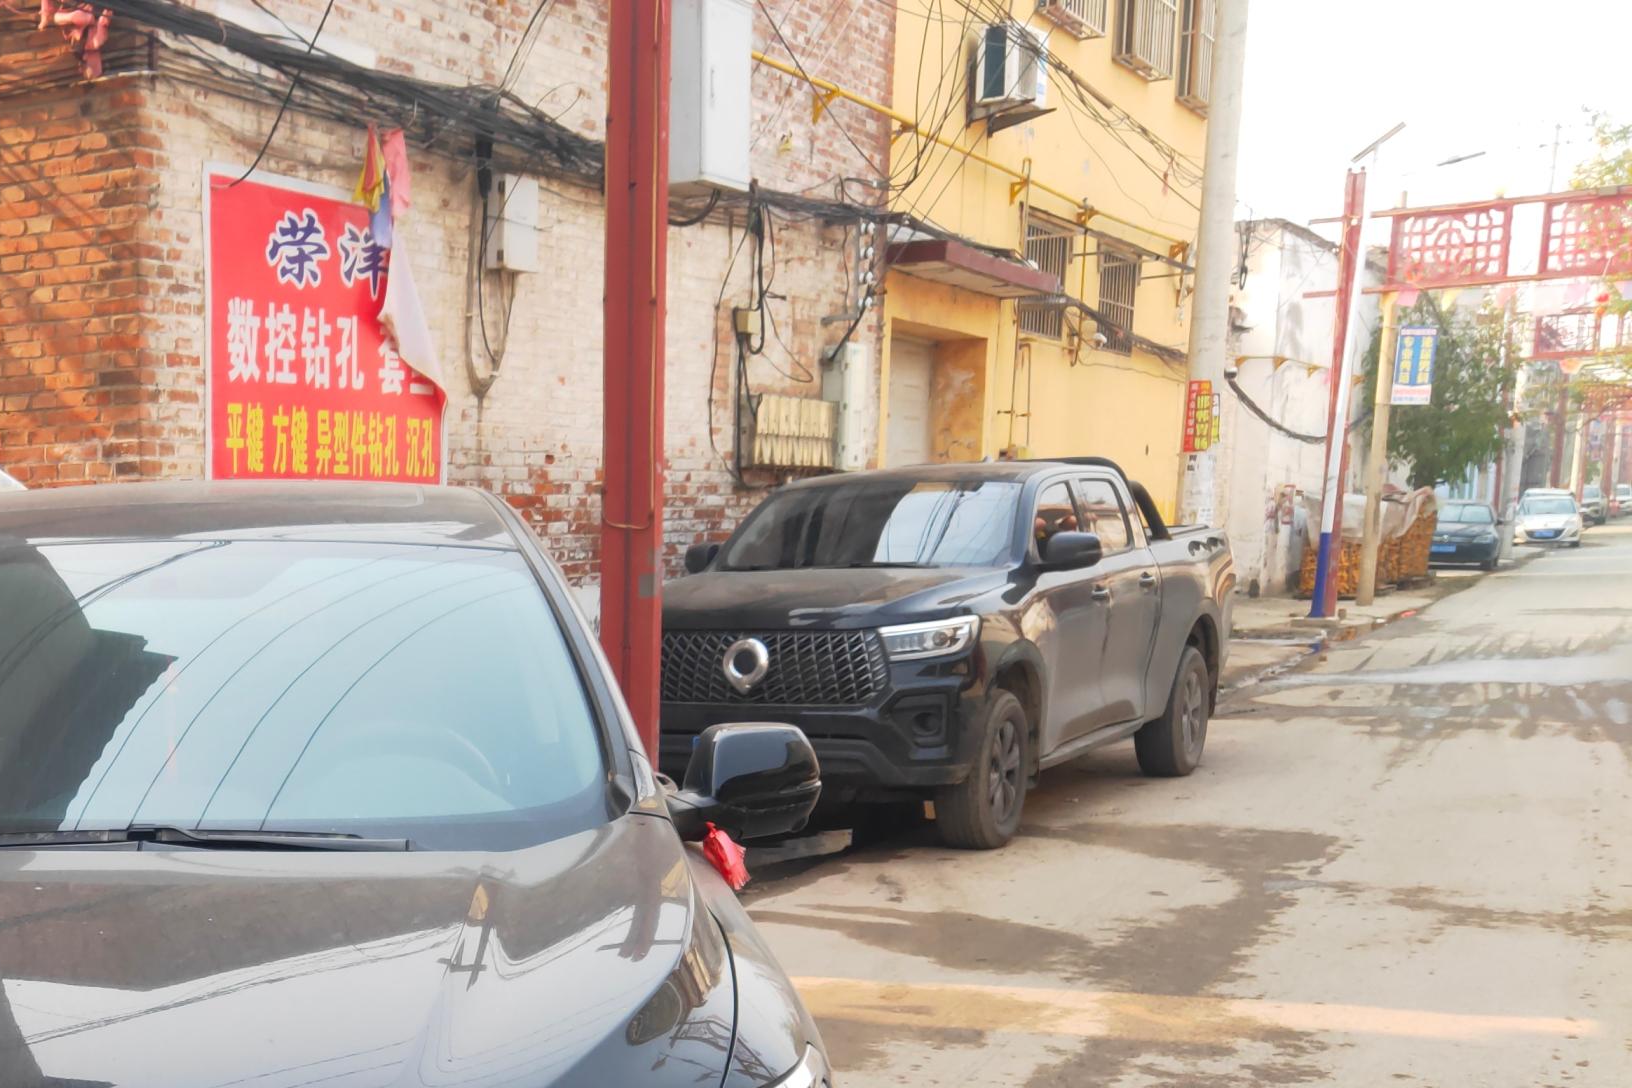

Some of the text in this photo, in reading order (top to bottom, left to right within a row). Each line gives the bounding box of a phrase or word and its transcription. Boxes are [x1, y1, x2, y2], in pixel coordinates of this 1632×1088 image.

[226, 298, 365, 391] 数控钻孔
[226, 402, 264, 474] 平键
[272, 405, 309, 475] 方键
[316, 410, 399, 478] 异型件钻孔
